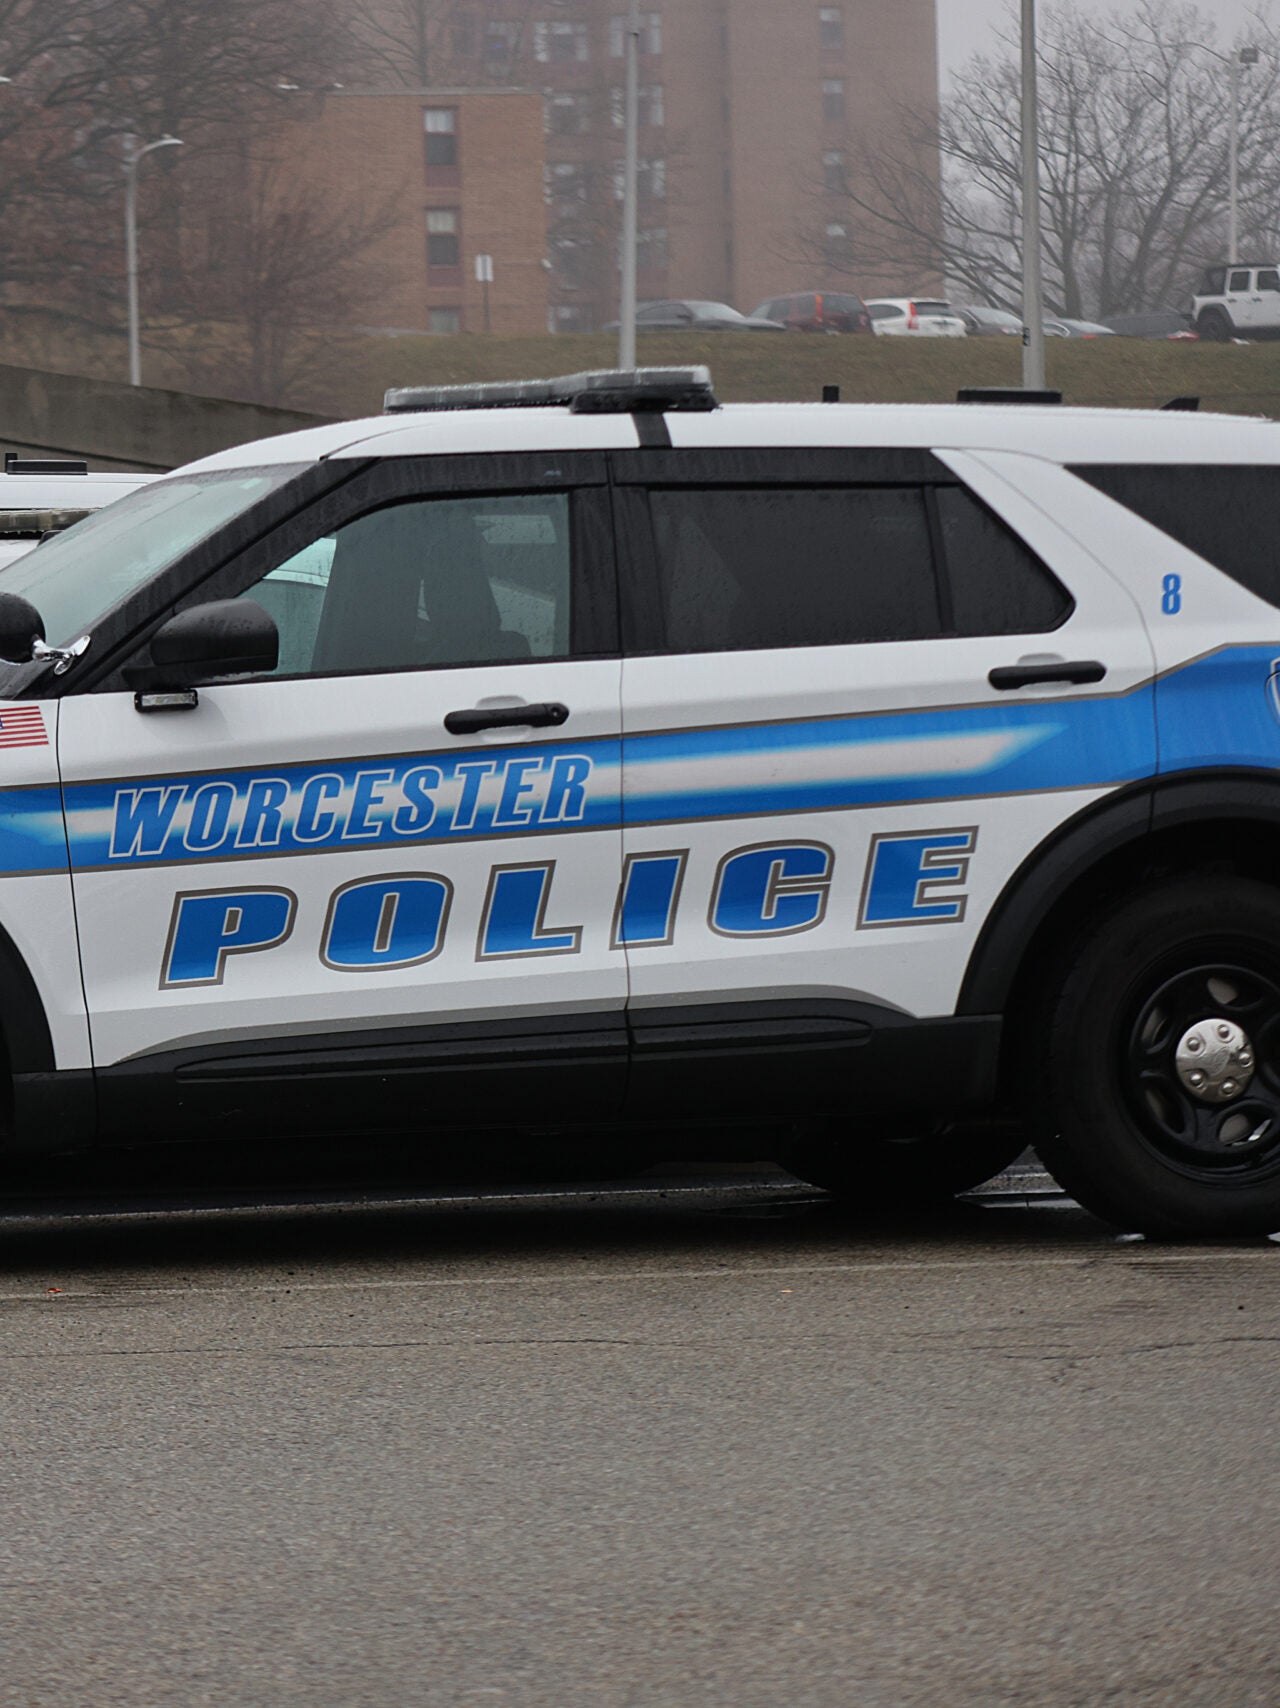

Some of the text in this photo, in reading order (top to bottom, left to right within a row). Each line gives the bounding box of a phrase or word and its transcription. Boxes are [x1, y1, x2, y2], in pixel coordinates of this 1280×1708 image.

[1162, 573, 1181, 615] 8
[108, 754, 594, 858] WORCESTER
[158, 825, 979, 991] POLICE
